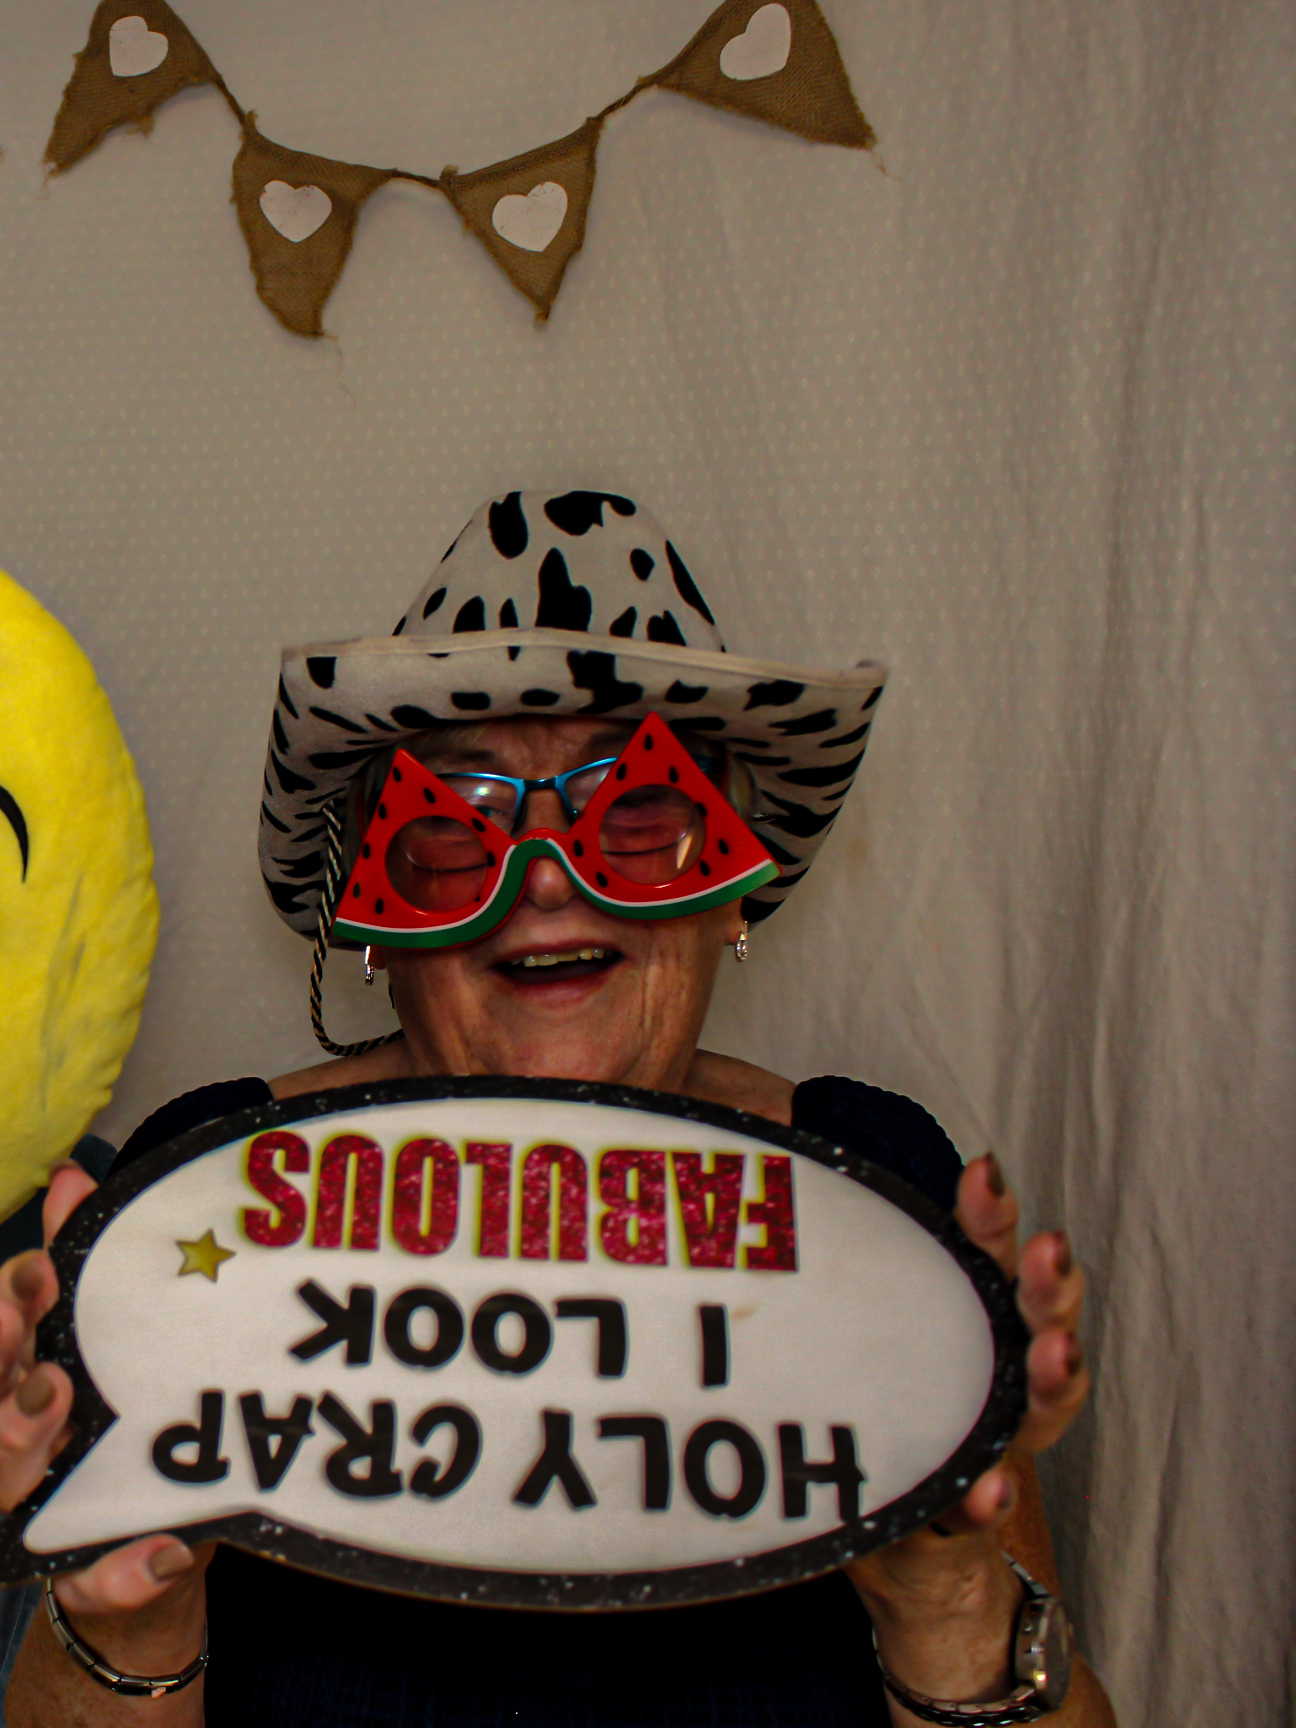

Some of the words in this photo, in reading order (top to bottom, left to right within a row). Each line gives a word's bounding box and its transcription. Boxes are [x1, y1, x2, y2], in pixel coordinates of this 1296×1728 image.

[239, 1130, 799, 1273] FABULOUS
[287, 1280, 630, 1380] LOOK
[696, 1304, 730, 1389] I
[150, 1389, 483, 1502] CRAP
[510, 1408, 866, 1523] HOLY
